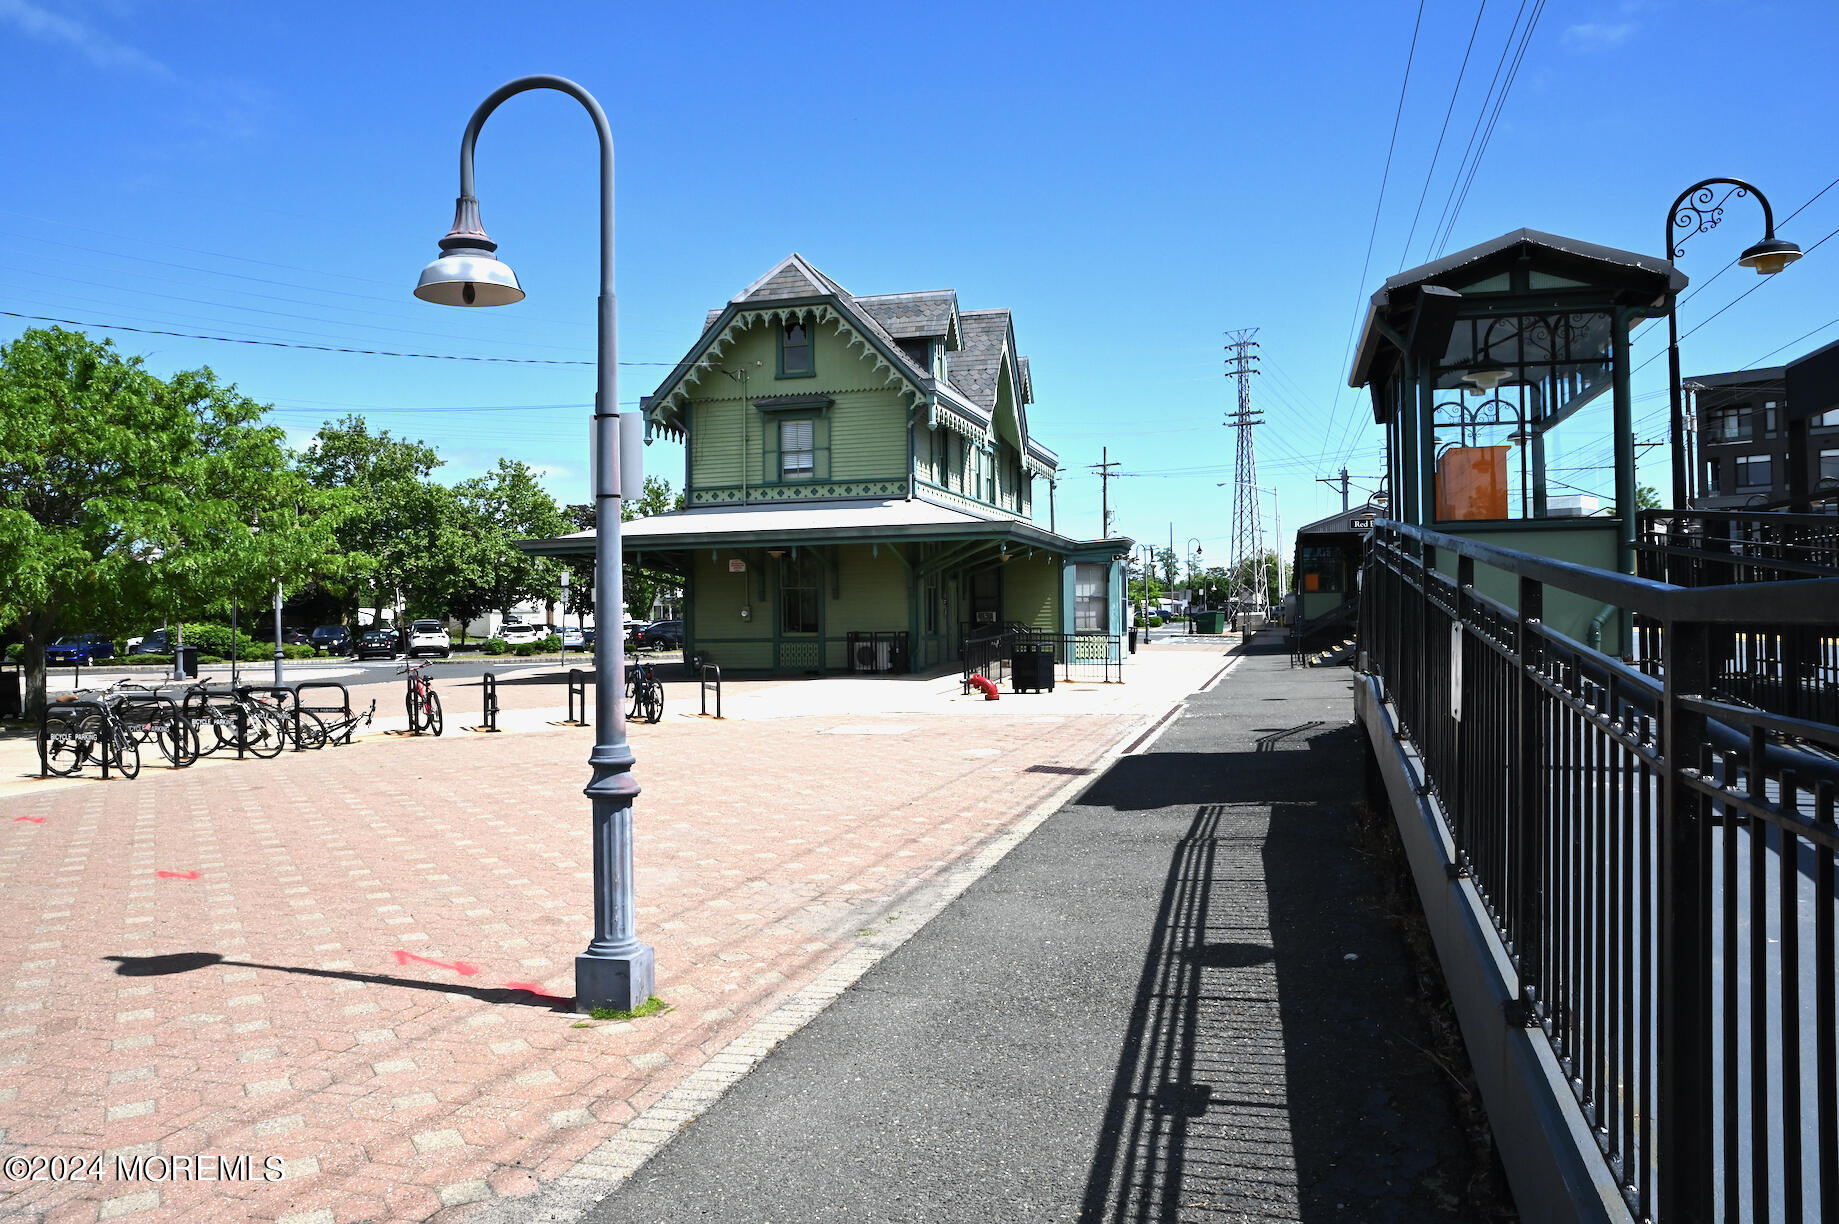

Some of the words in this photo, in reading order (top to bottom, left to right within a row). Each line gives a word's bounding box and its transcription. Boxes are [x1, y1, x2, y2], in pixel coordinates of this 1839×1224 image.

[1354, 520, 1369, 528] Red
[50, 733, 72, 741] BICYCLE
[74, 733, 98, 741] PARKING
